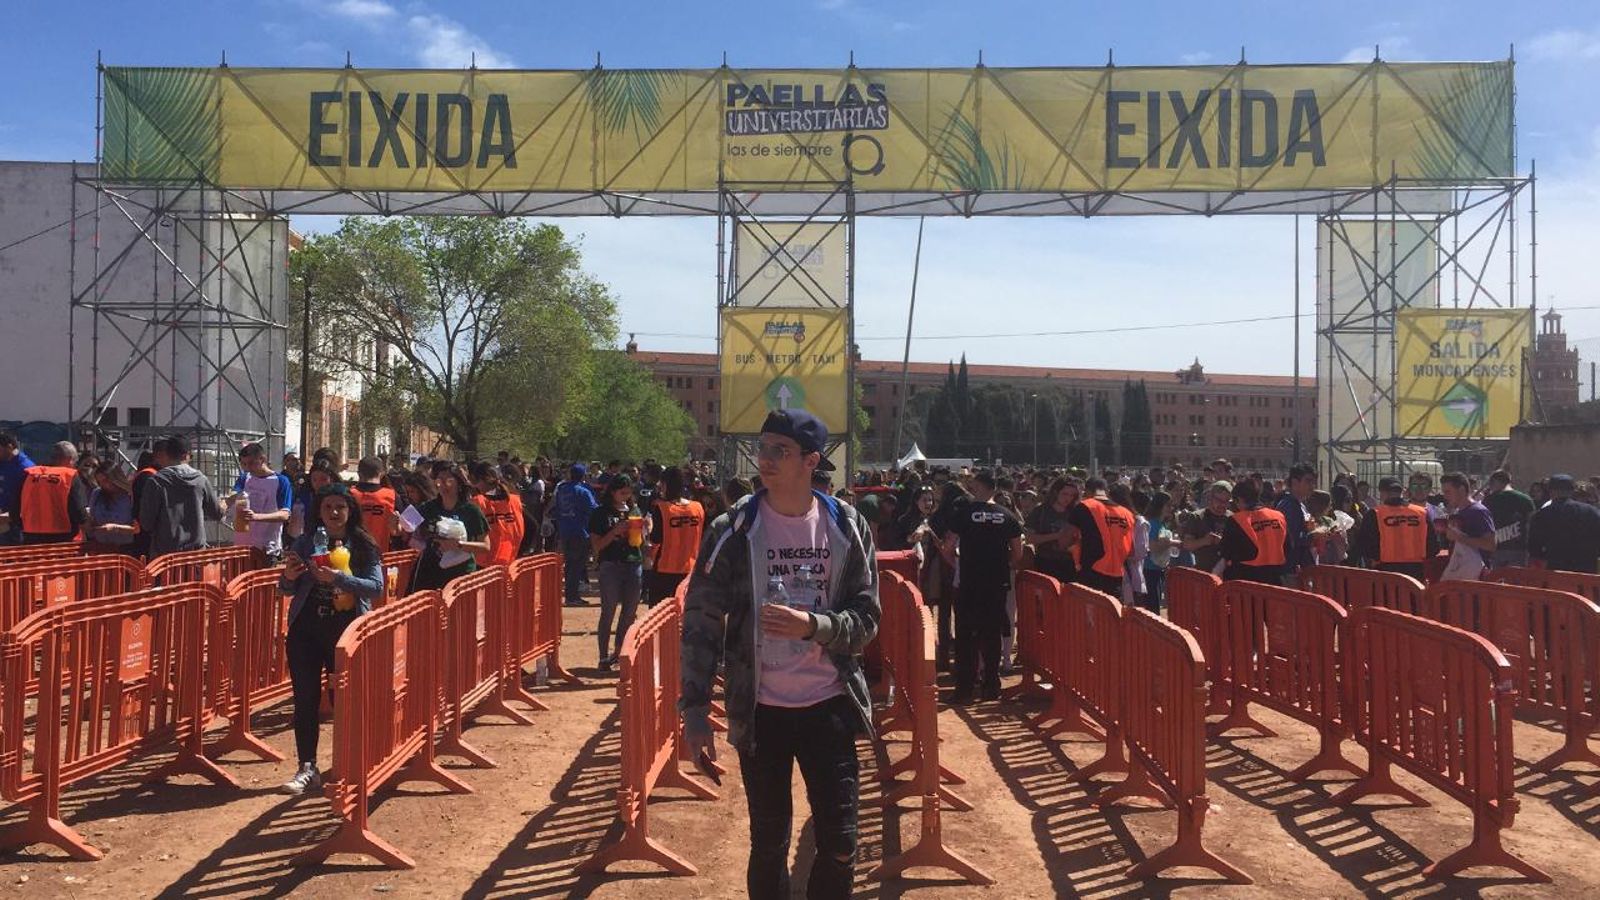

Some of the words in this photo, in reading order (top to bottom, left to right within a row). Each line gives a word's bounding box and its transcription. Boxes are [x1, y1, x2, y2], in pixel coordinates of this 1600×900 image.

[727, 83, 887, 107] PAELLAS
[728, 105, 887, 133] UNIVERSITARIAS
[308, 90, 517, 169] EIXIDA
[1105, 89, 1327, 169] EIXIDA
[727, 143, 747, 157] las
[750, 143, 771, 157] de
[774, 143, 833, 161] siempre
[1429, 341, 1500, 359] SALIDA
[735, 354, 755, 365] BUS
[766, 354, 801, 365] METRO
[810, 354, 835, 365] TAXI
[779, 547, 831, 560] NECESITO
[768, 563, 791, 577] UNA
